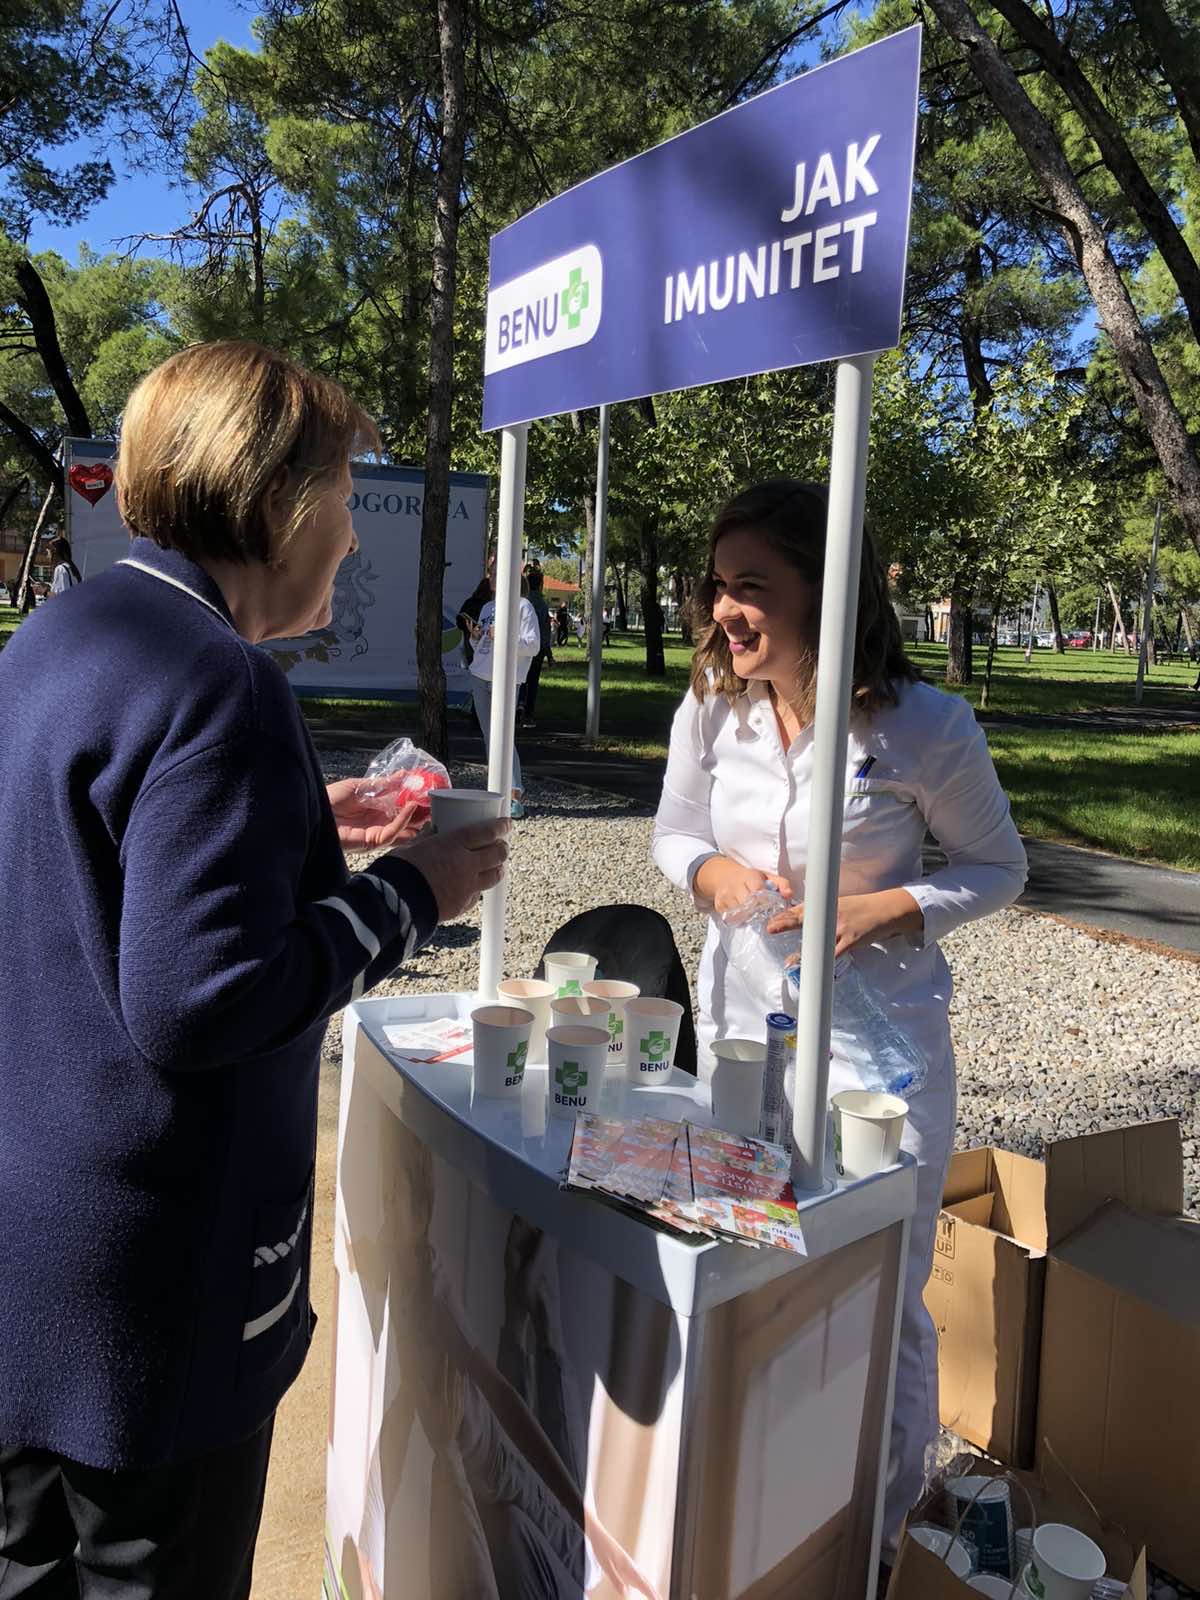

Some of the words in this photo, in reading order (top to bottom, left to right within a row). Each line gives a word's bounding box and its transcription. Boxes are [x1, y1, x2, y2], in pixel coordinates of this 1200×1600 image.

[780, 134, 881, 222] JAK
[664, 211, 877, 324] IMUNITET
[498, 293, 558, 354] BENU
[347, 491, 470, 520] GORA
[640, 1061, 669, 1072] BENU
[555, 1093, 587, 1107] BENU
[937, 1239, 953, 1254] UP
